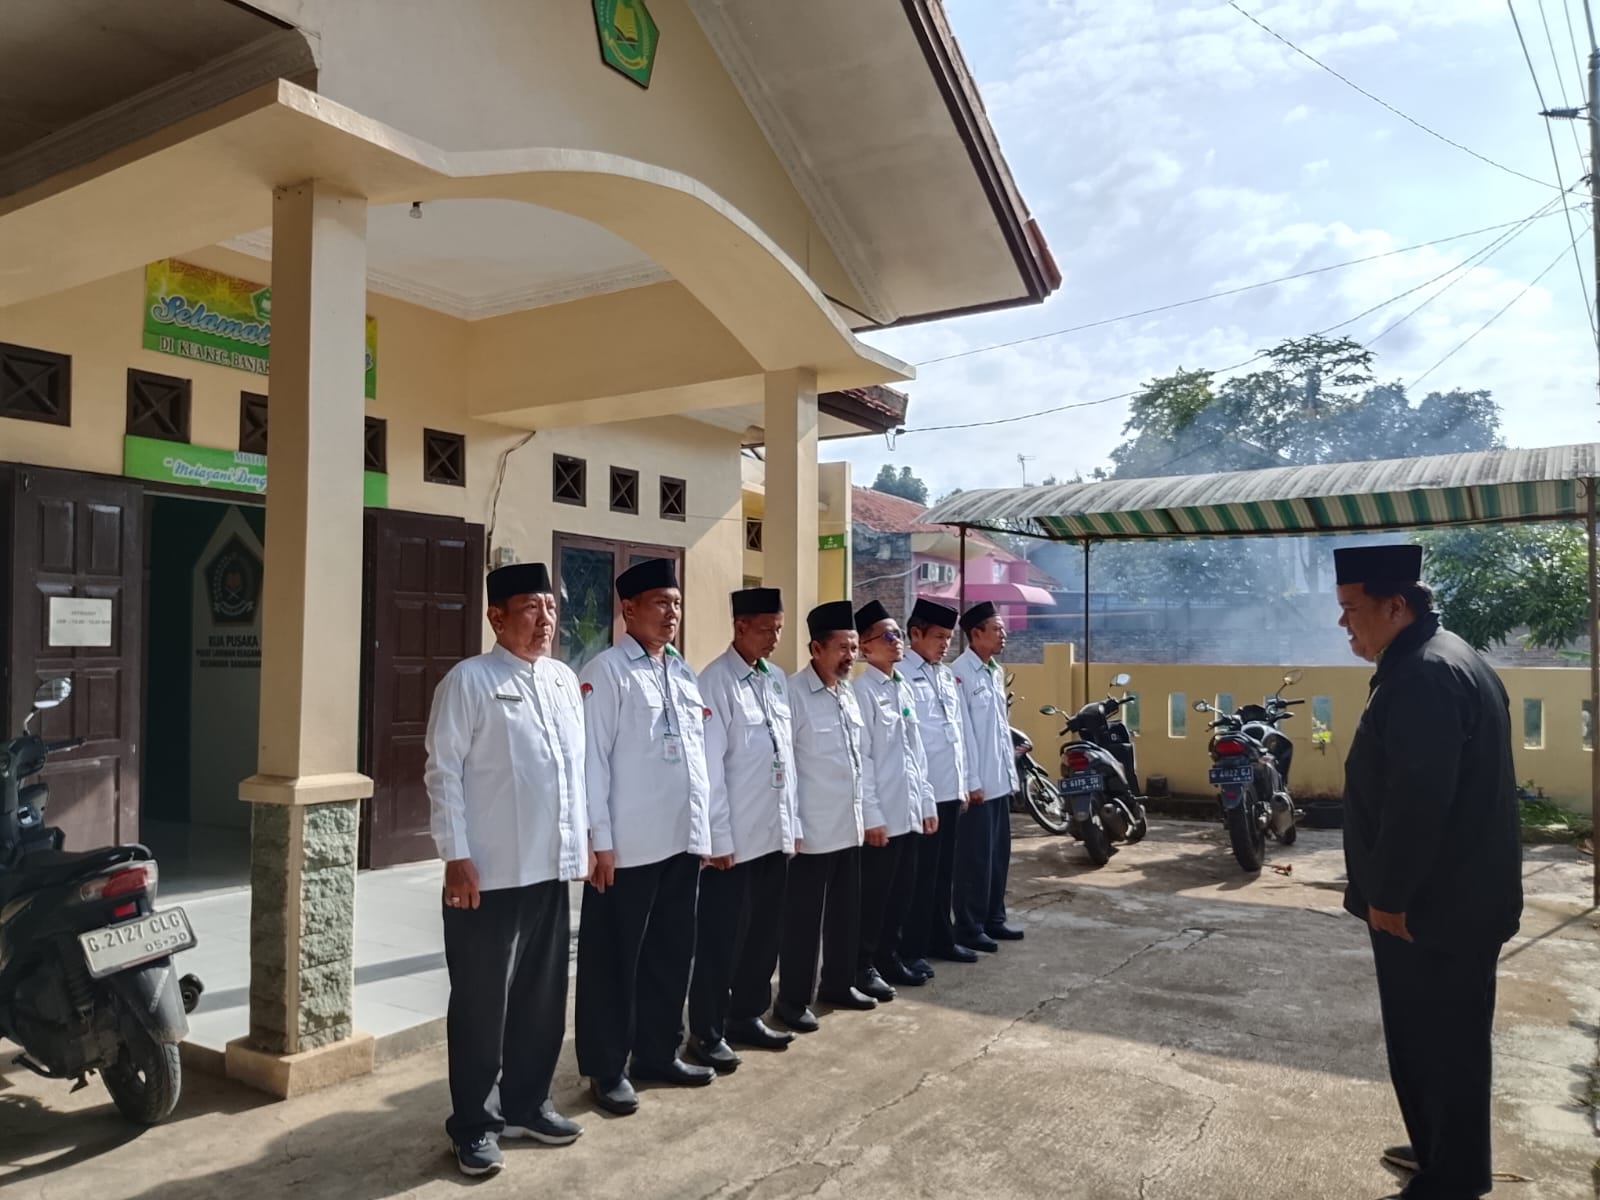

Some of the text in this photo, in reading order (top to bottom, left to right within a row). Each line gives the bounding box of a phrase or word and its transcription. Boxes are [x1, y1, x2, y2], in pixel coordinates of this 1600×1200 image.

[153, 295, 271, 345] Selamat
[160, 337, 174, 353] DI
[179, 341, 204, 359] KUA
[232, 352, 270, 374] BANJAR
[234, 469, 266, 490] Deng
